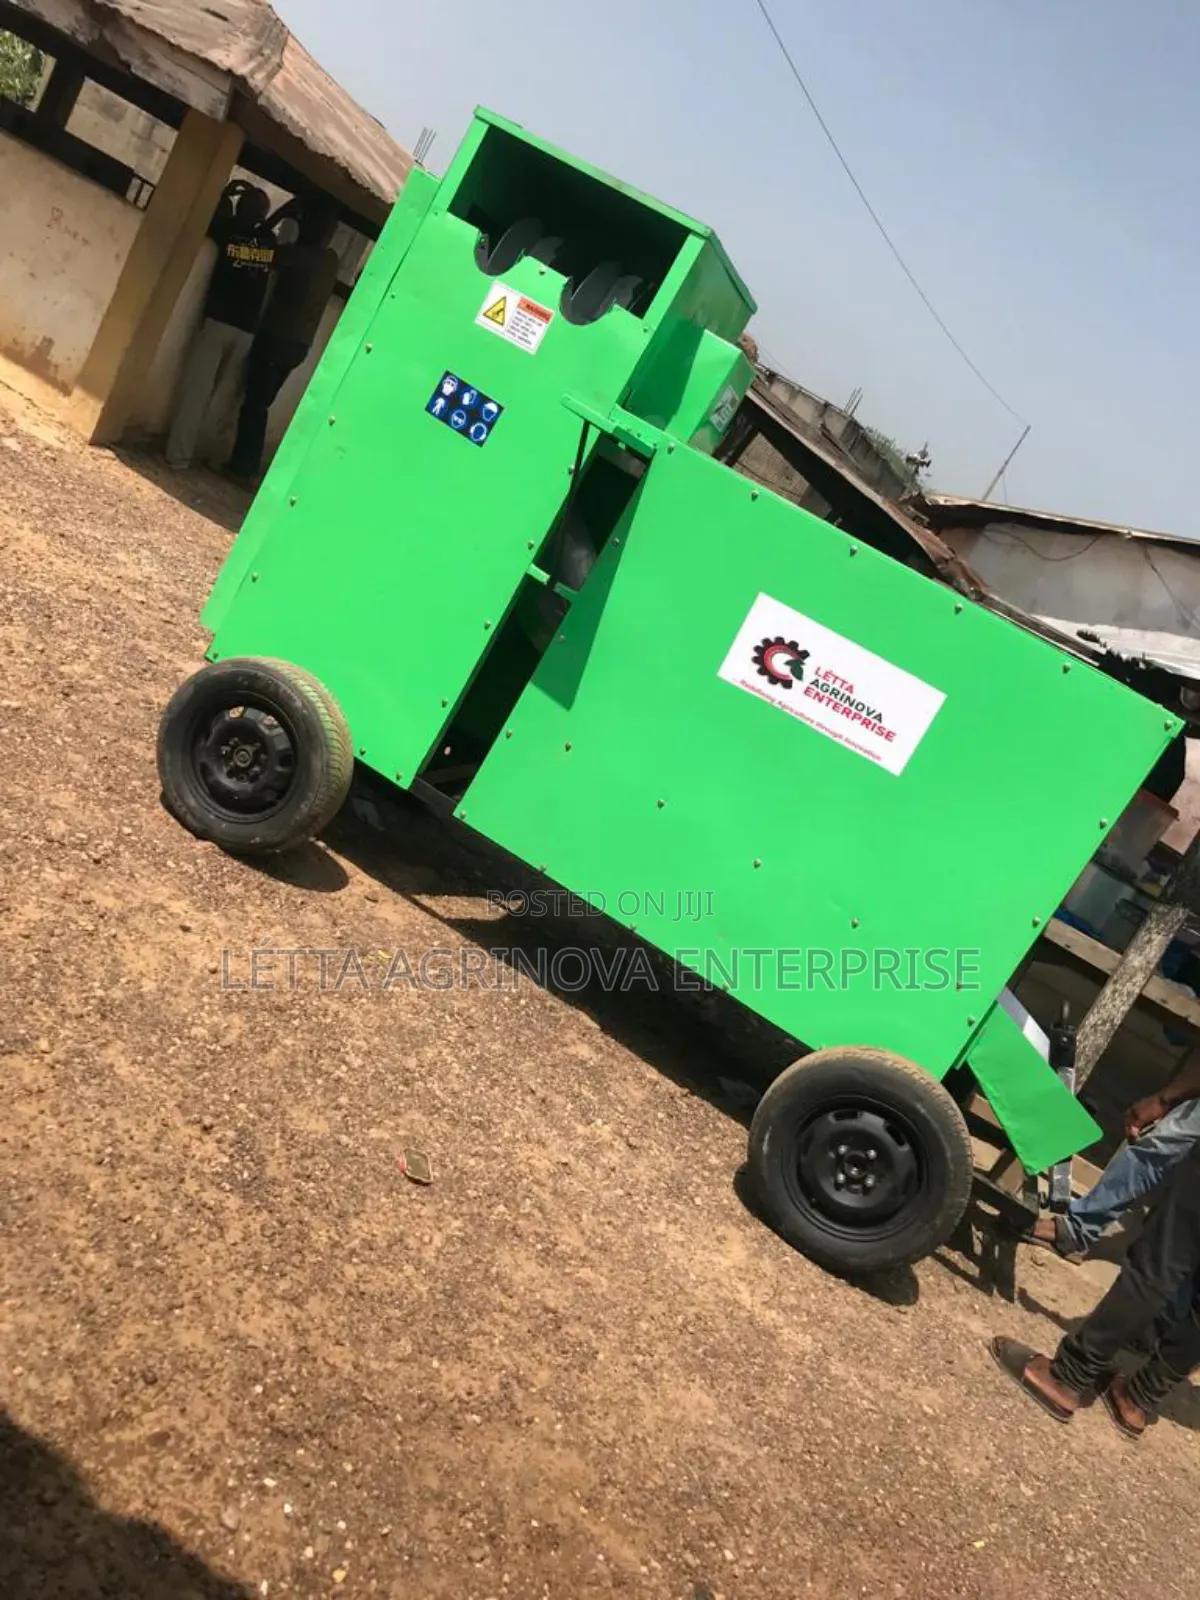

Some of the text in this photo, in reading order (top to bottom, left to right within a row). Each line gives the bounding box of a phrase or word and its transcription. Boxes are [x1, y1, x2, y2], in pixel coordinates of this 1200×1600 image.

[810, 678, 883, 724] AGRINOVA
[814, 666, 855, 694] LÉTTA
[803, 685, 897, 742] ENTERPRISE
